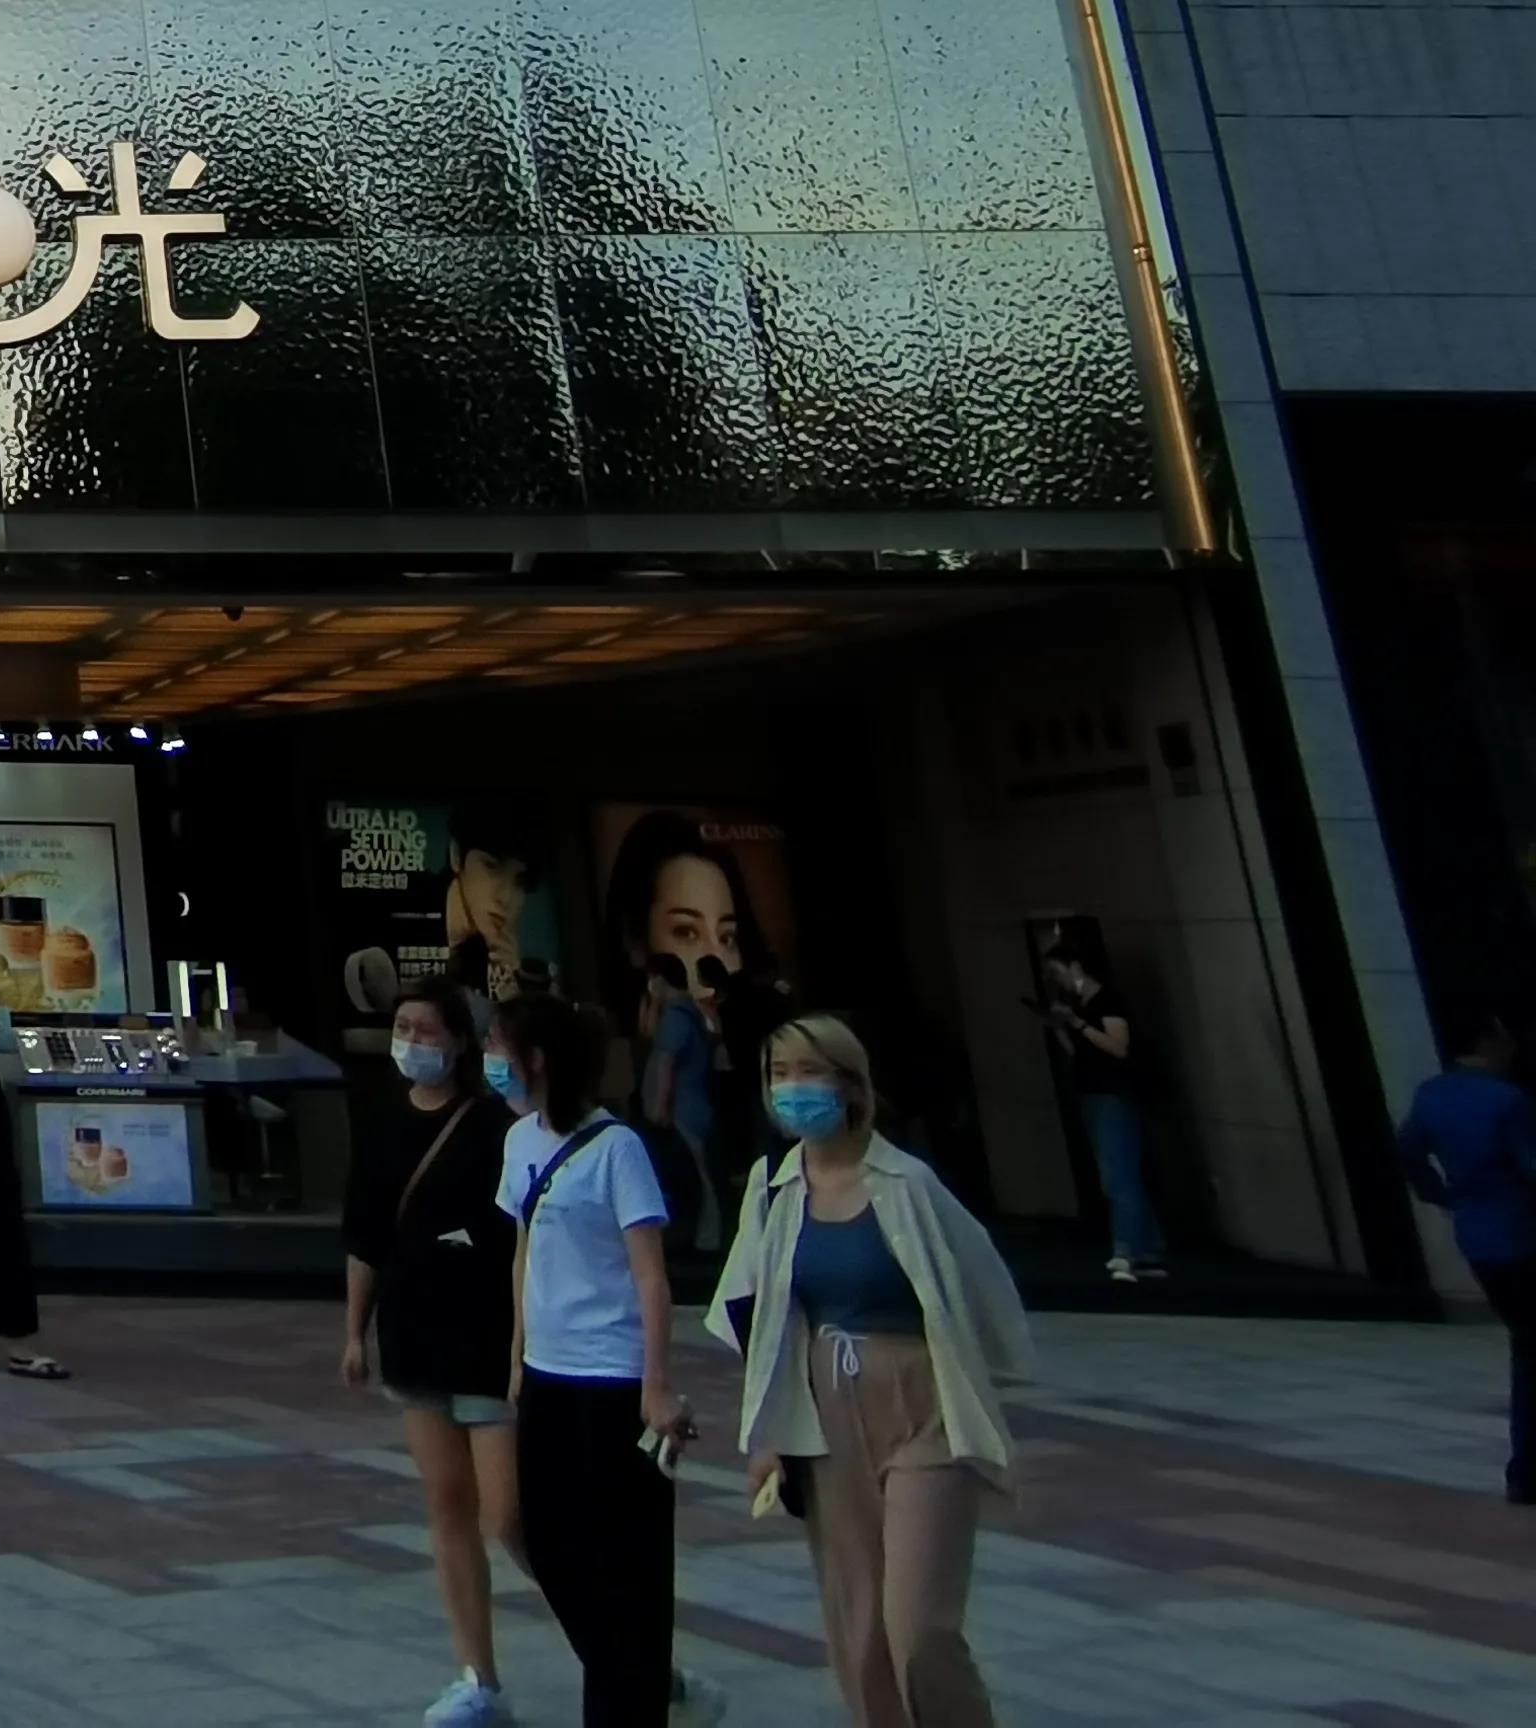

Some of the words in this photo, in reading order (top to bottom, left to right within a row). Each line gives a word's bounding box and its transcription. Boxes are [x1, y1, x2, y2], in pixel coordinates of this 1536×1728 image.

[326, 800, 386, 830] ULTRA
[388, 808, 419, 831] HD
[350, 829, 428, 851] SETTING
[340, 849, 426, 872] POWDER
